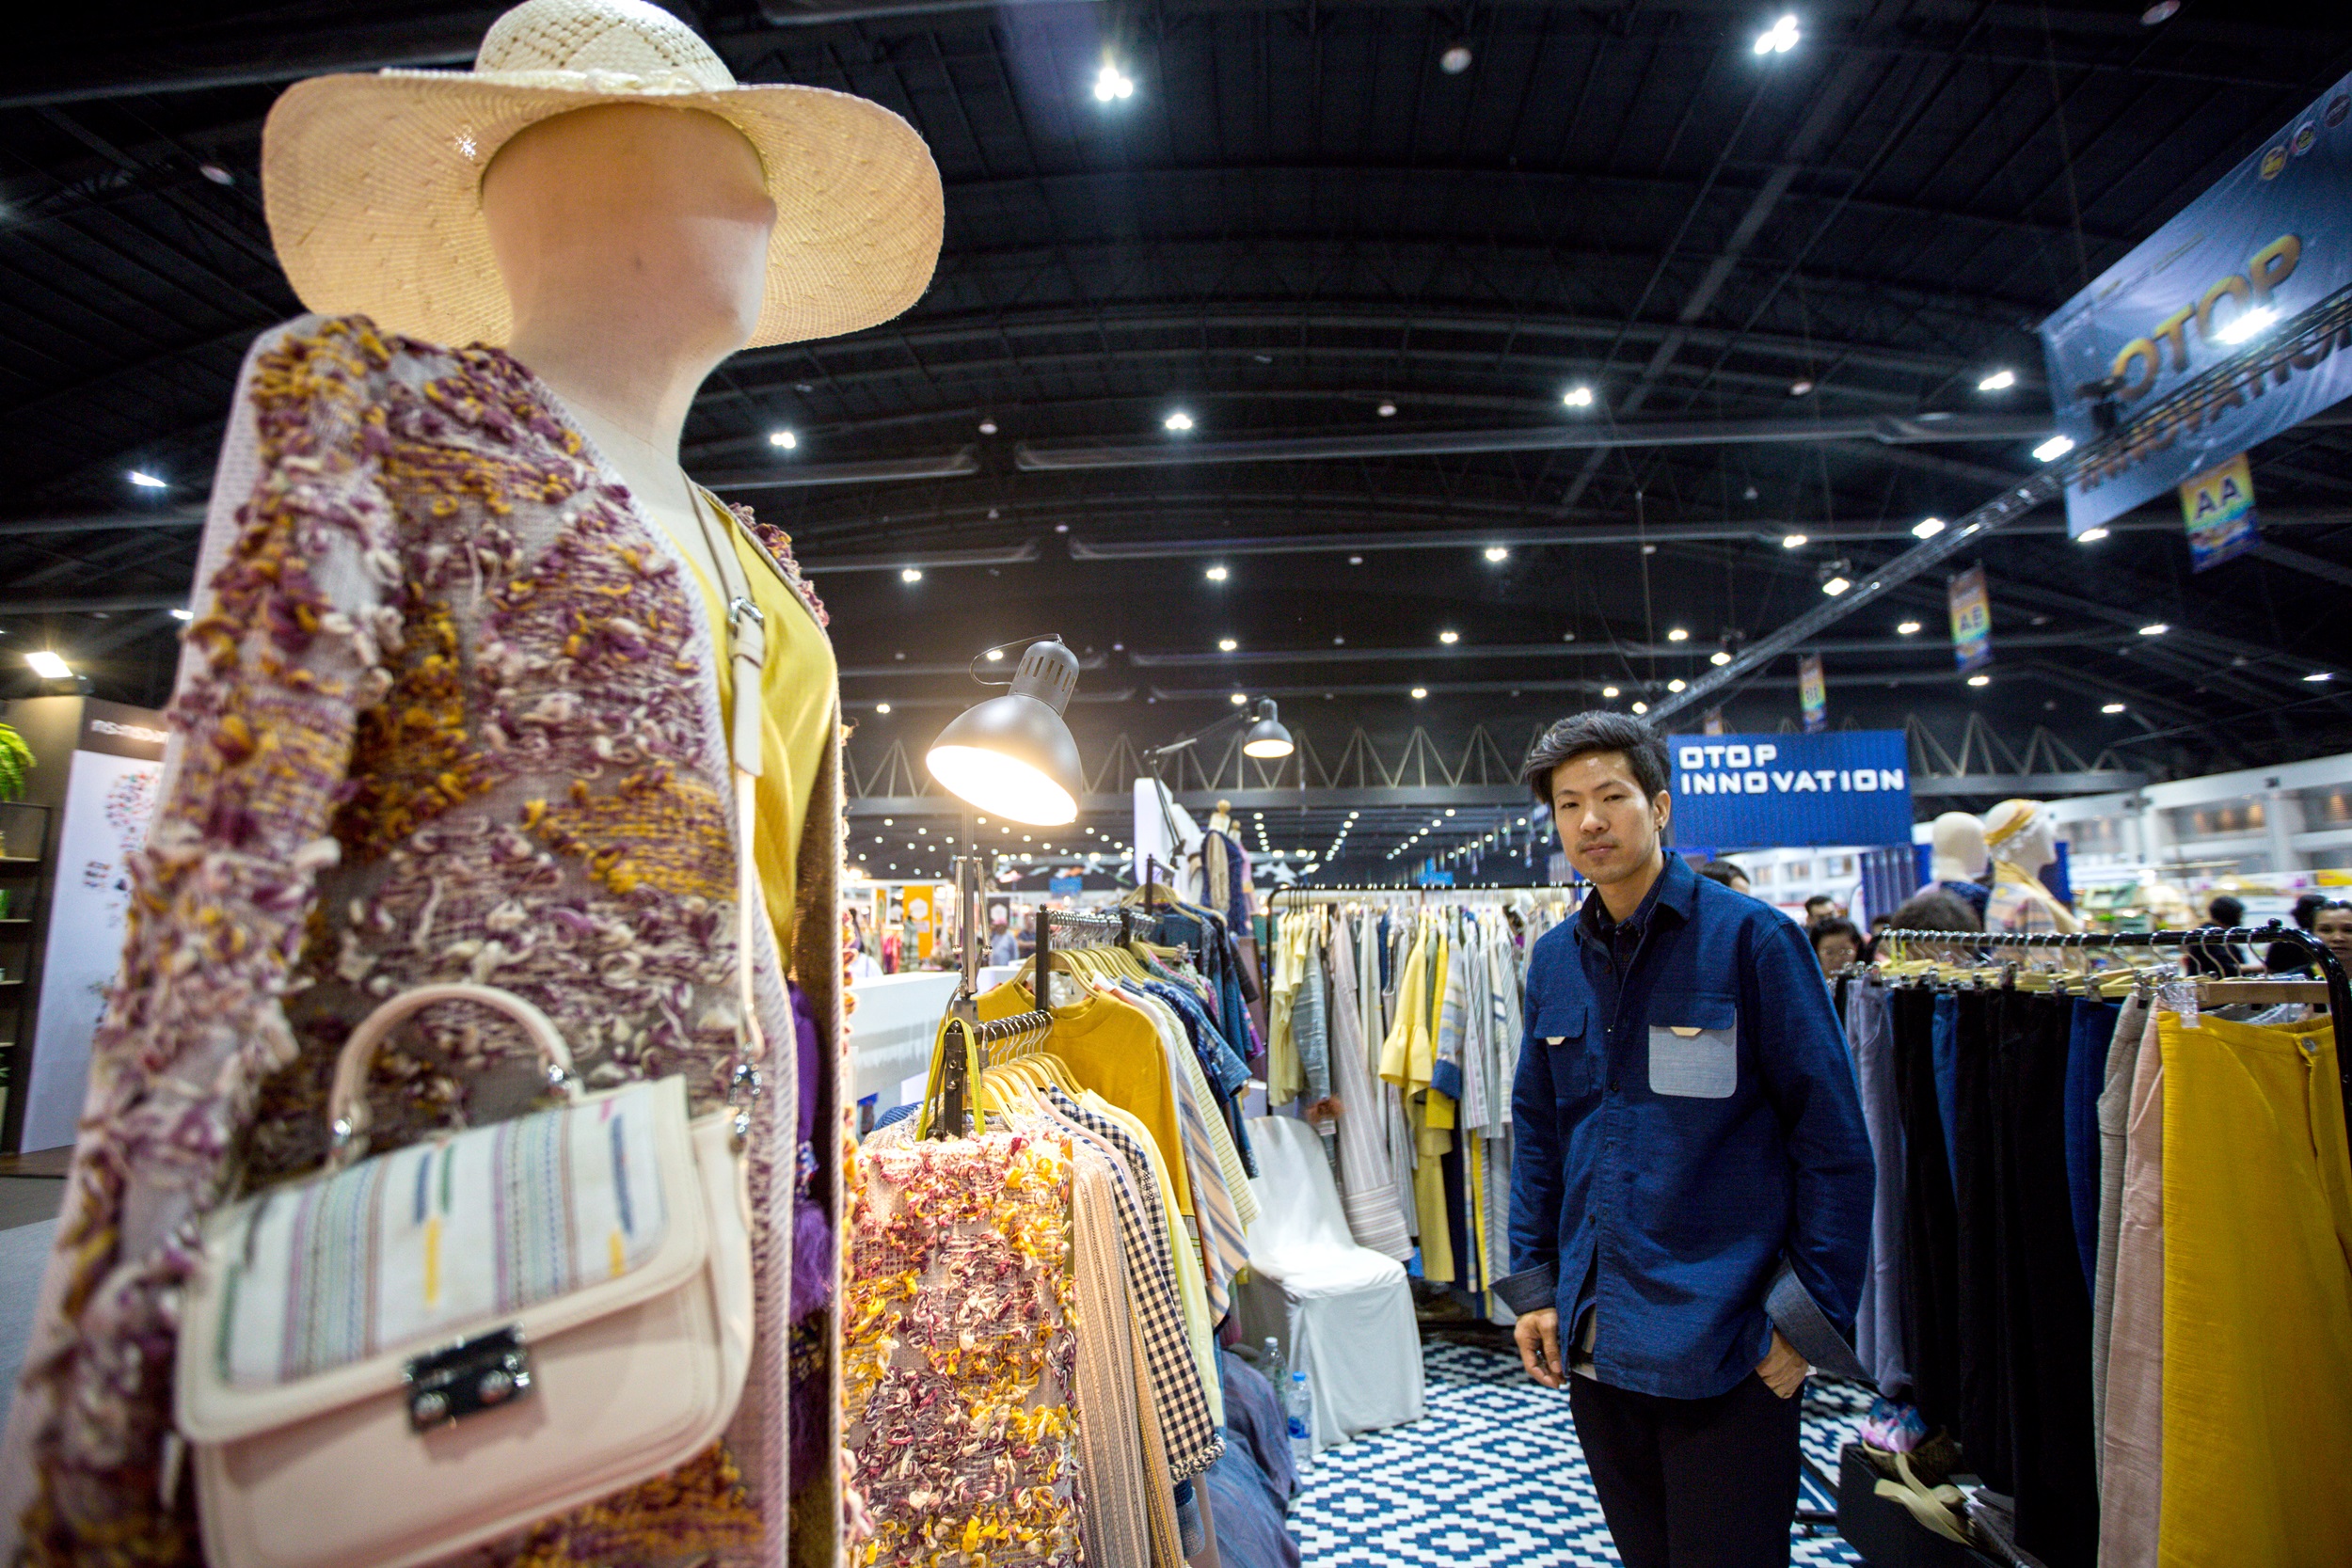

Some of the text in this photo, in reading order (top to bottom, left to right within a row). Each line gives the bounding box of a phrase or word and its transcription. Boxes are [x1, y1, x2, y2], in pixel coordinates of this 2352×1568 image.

[2111, 234, 2301, 401] OTOP
[1678, 744, 1777, 769] OTOP
[1680, 768, 1905, 795] INNOVATION
